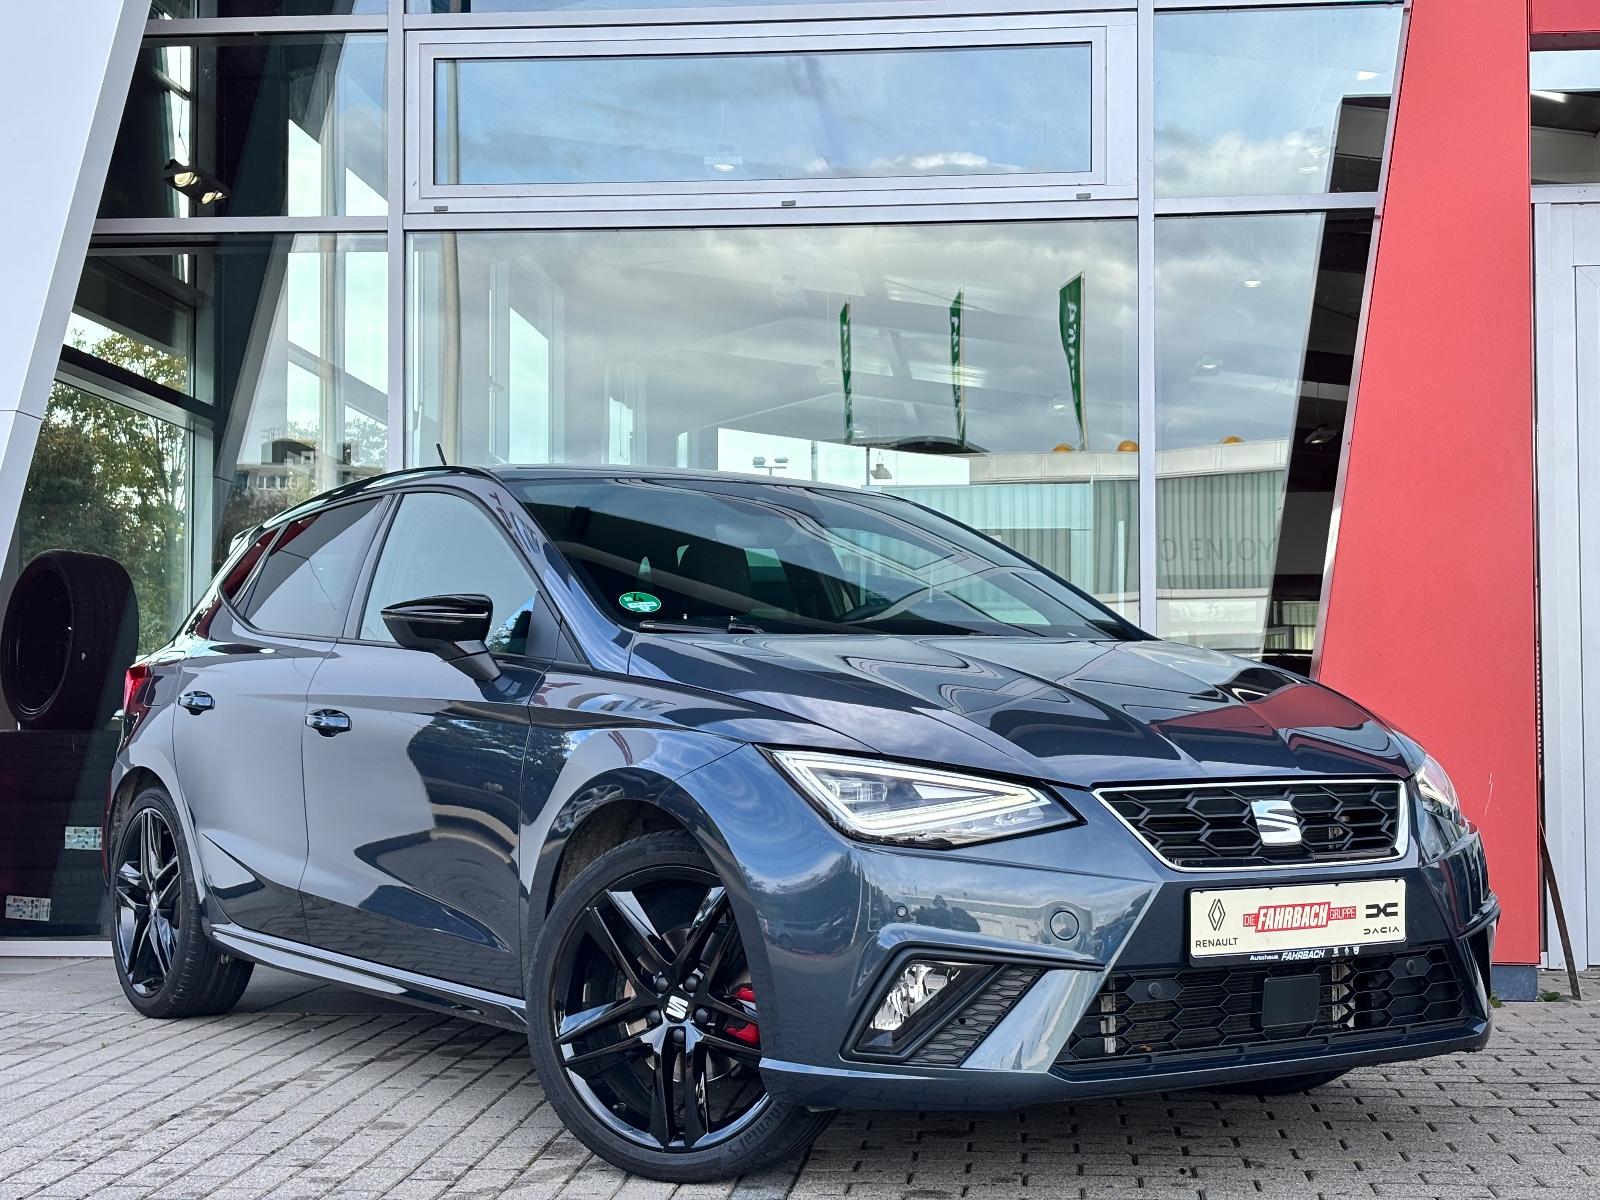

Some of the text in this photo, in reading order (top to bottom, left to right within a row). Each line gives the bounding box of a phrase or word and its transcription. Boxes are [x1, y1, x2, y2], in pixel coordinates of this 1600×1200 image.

[1190, 536, 1276, 564] ENJOY
[1243, 903, 1356, 931] DIE FAHRBACH GRUPPE
[1363, 925, 1400, 935] DACIA
[1195, 937, 1238, 948] RENAULT
[1280, 949, 1325, 961] FAHRBACH
